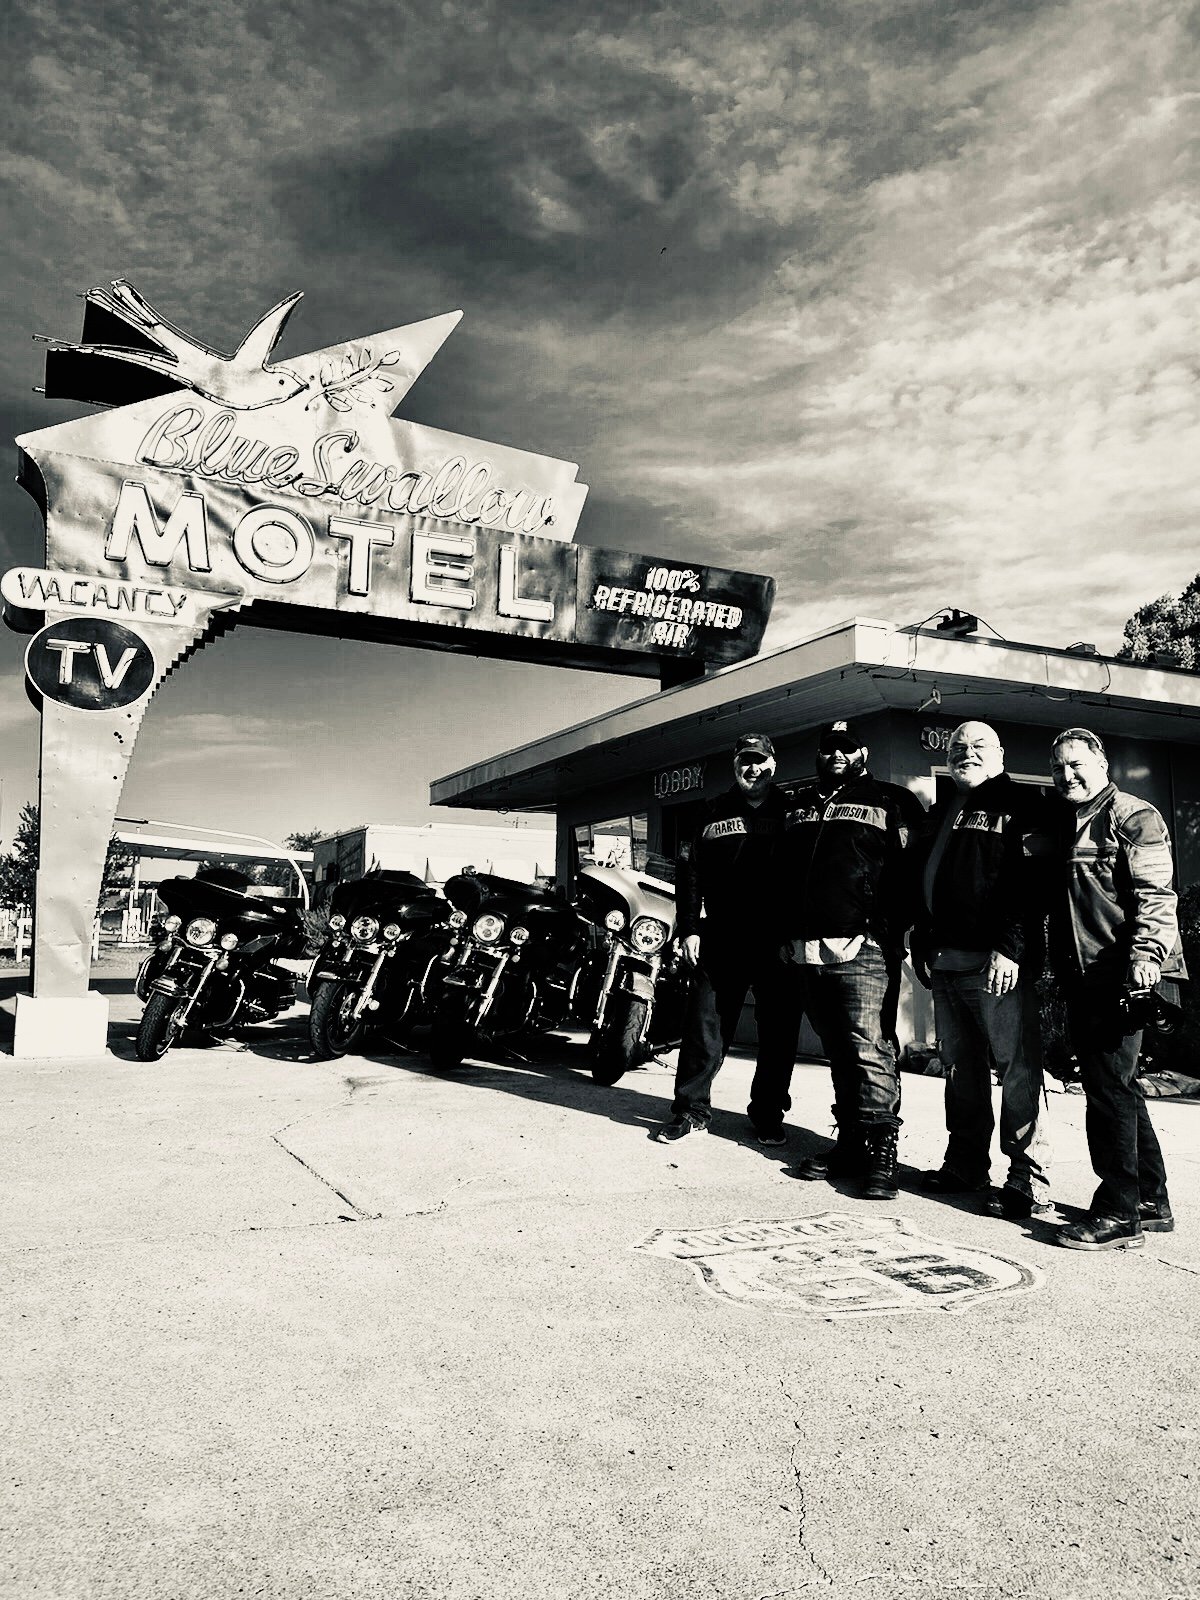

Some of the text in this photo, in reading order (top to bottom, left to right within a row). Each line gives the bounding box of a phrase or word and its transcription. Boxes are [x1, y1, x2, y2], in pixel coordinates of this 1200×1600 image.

[135, 402, 557, 533] Blue Swallow
[104, 479, 554, 622] MOTEL
[18, 571, 188, 617] VACANCY
[645, 567, 700, 593] 100%
[593, 585, 743, 629] REFRIGERATED
[651, 620, 692, 648] AIR
[45, 638, 139, 690] TV
[653, 762, 706, 798] LOBBY
